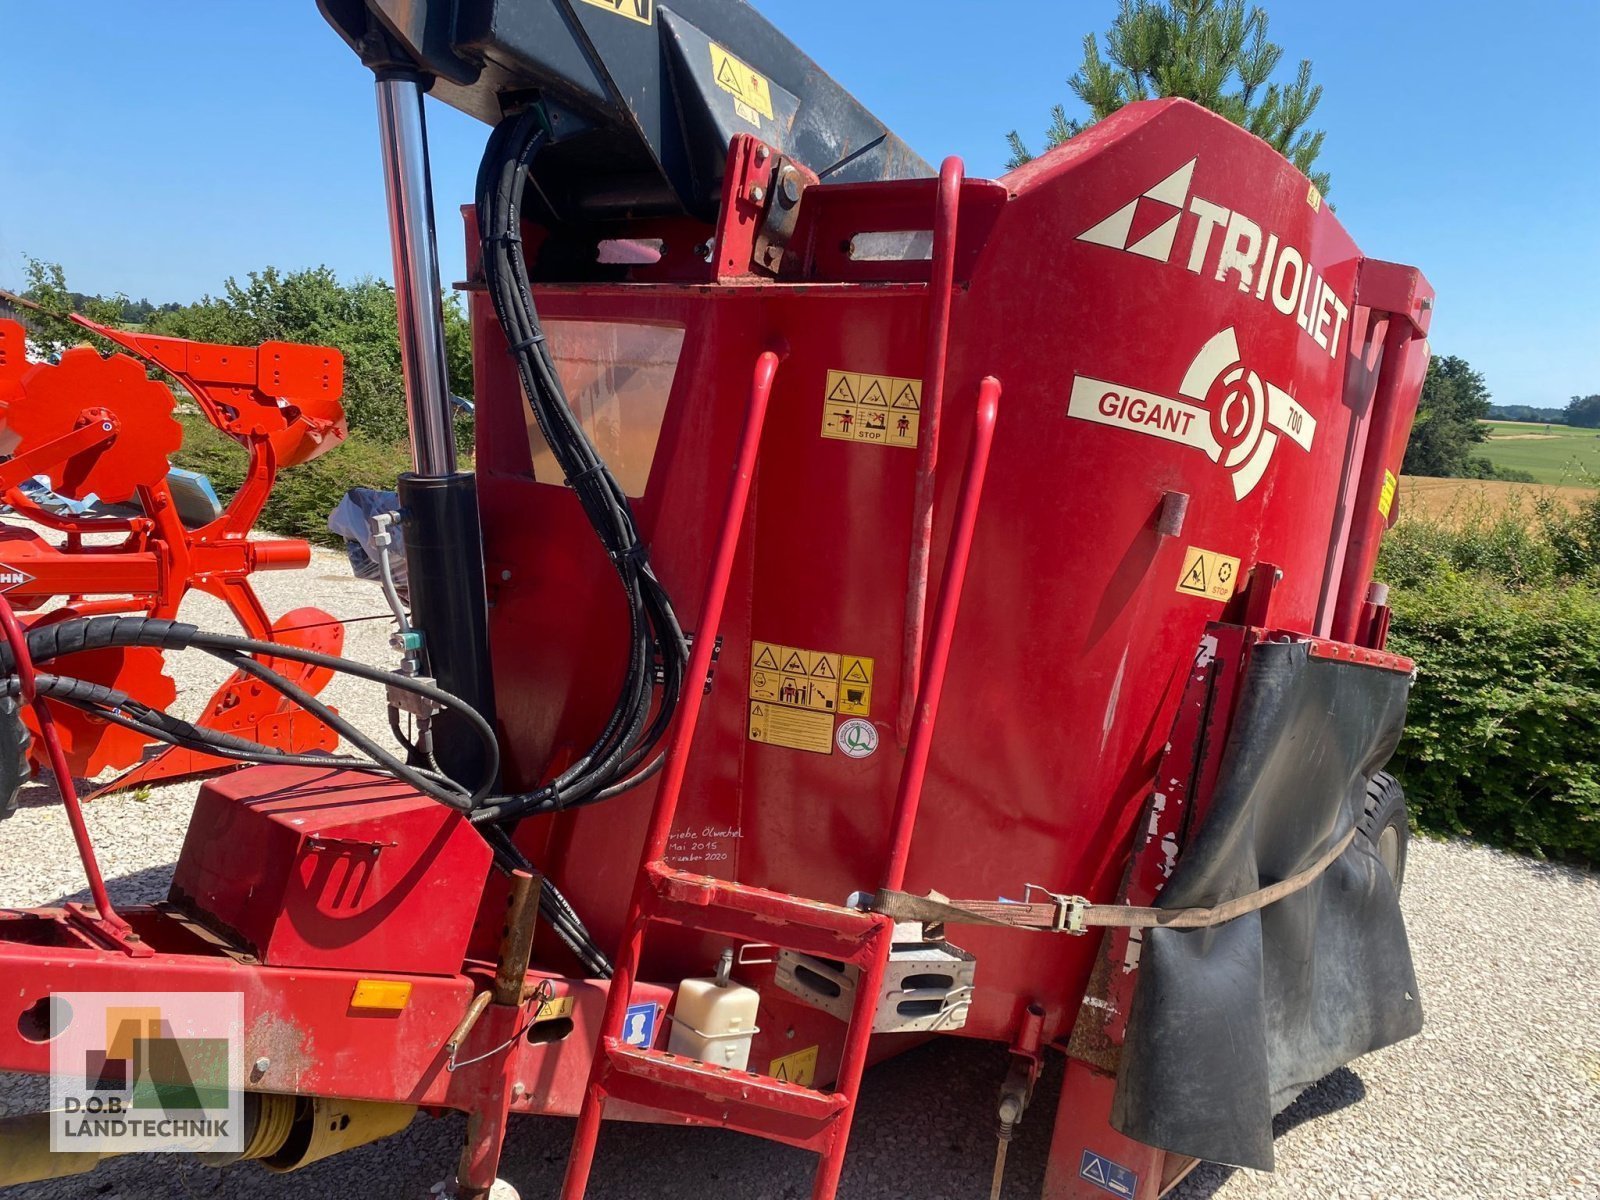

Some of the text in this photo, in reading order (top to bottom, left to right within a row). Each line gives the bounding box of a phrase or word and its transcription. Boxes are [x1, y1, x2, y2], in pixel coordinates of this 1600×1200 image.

[1187, 195, 1349, 360] TRIOLIET
[1098, 391, 1196, 436] GIGANT
[1287, 406, 1303, 435] 700
[858, 431, 880, 440] STOP
[1212, 586, 1228, 596] STOP
[669, 842, 718, 850] Mai 2015
